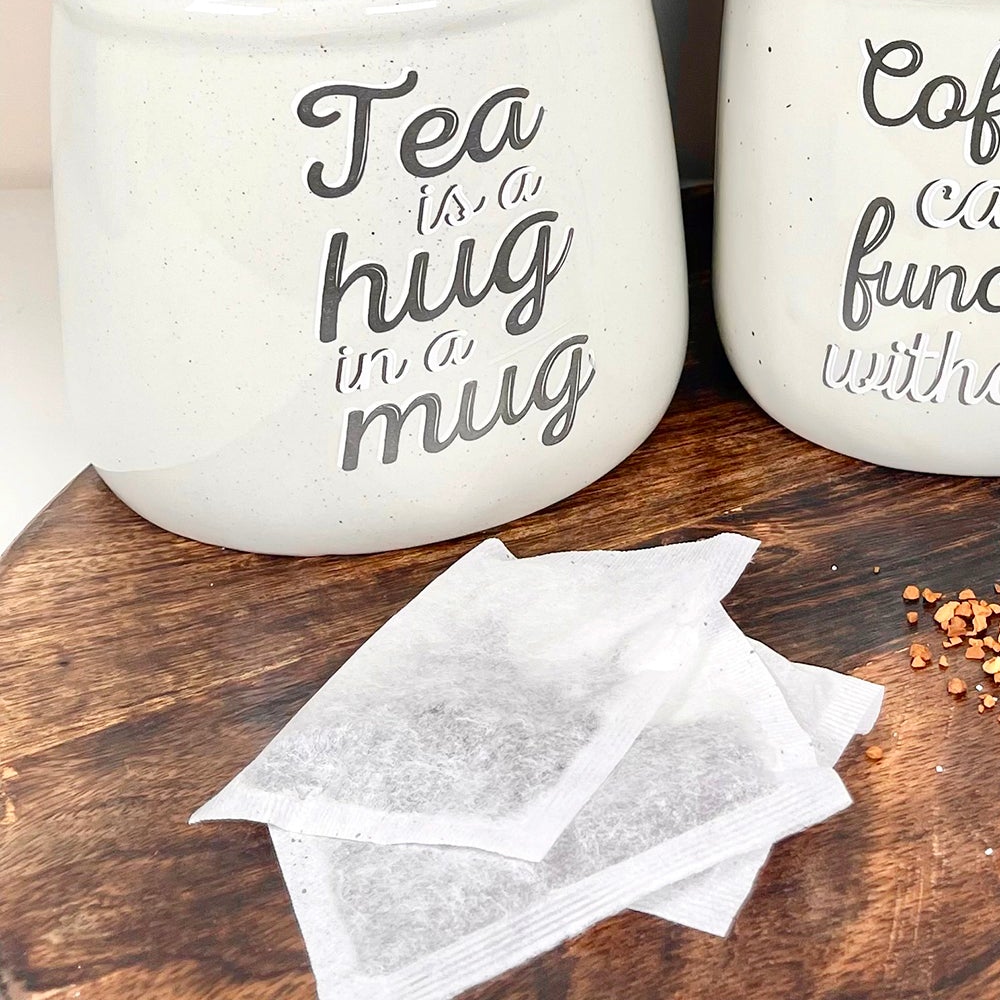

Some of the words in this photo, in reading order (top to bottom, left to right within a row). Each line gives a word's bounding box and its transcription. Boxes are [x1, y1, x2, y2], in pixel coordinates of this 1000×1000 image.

[294, 70, 544, 198] Tea
[417, 184, 486, 235] is
[498, 165, 542, 210] a
[318, 211, 574, 343] hug
[335, 346, 407, 393] in
[423, 329, 473, 372] a
[340, 334, 596, 471] mug
